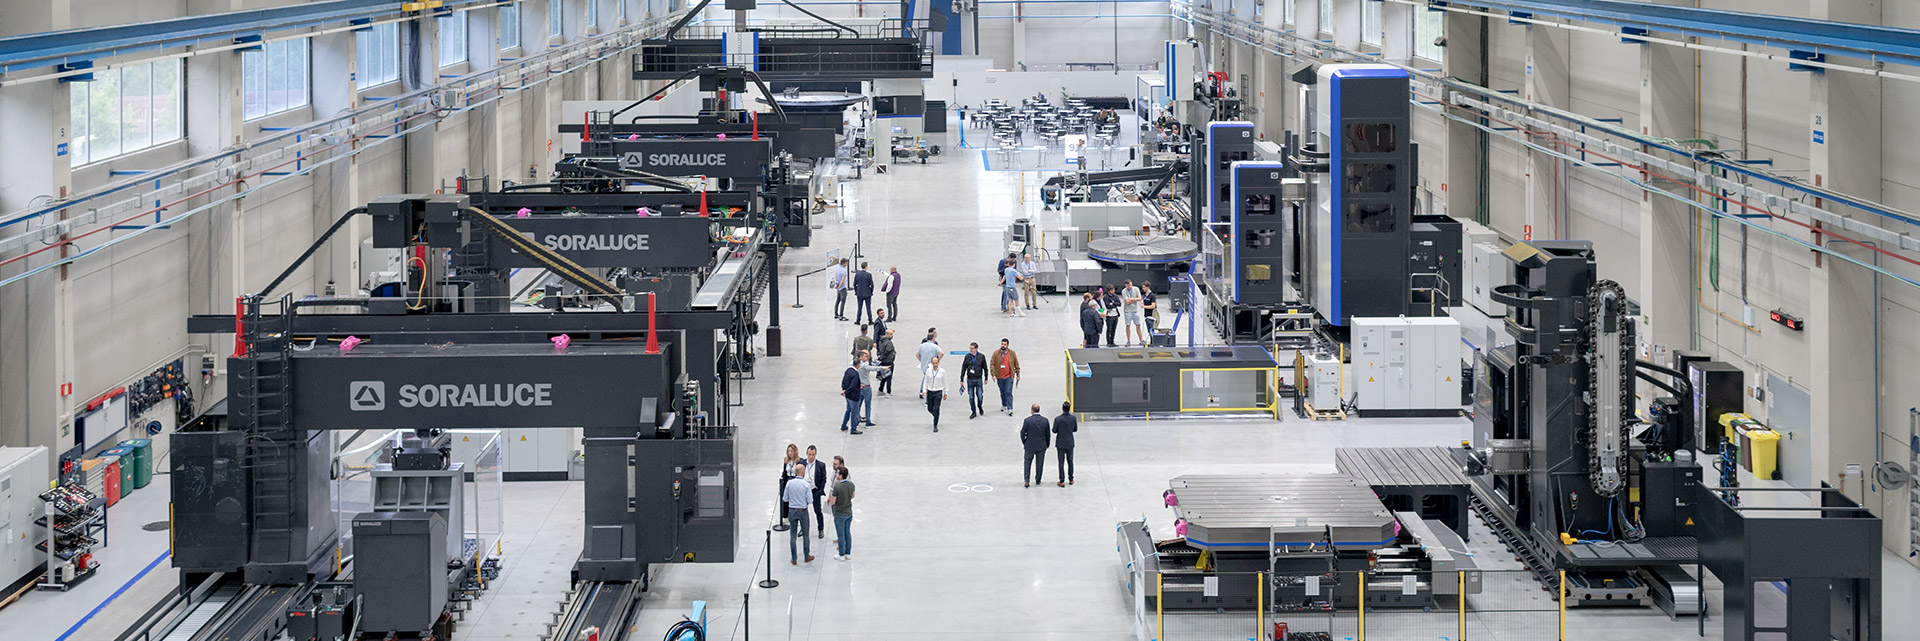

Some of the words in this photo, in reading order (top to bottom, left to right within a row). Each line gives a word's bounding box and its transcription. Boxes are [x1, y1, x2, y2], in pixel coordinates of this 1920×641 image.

[60, 127, 65, 138] 5
[649, 153, 726, 166] SORALUCE
[544, 234, 650, 251] SORALUCE
[398, 383, 552, 408] SORALUCE
[947, 482, 994, 493] 60
